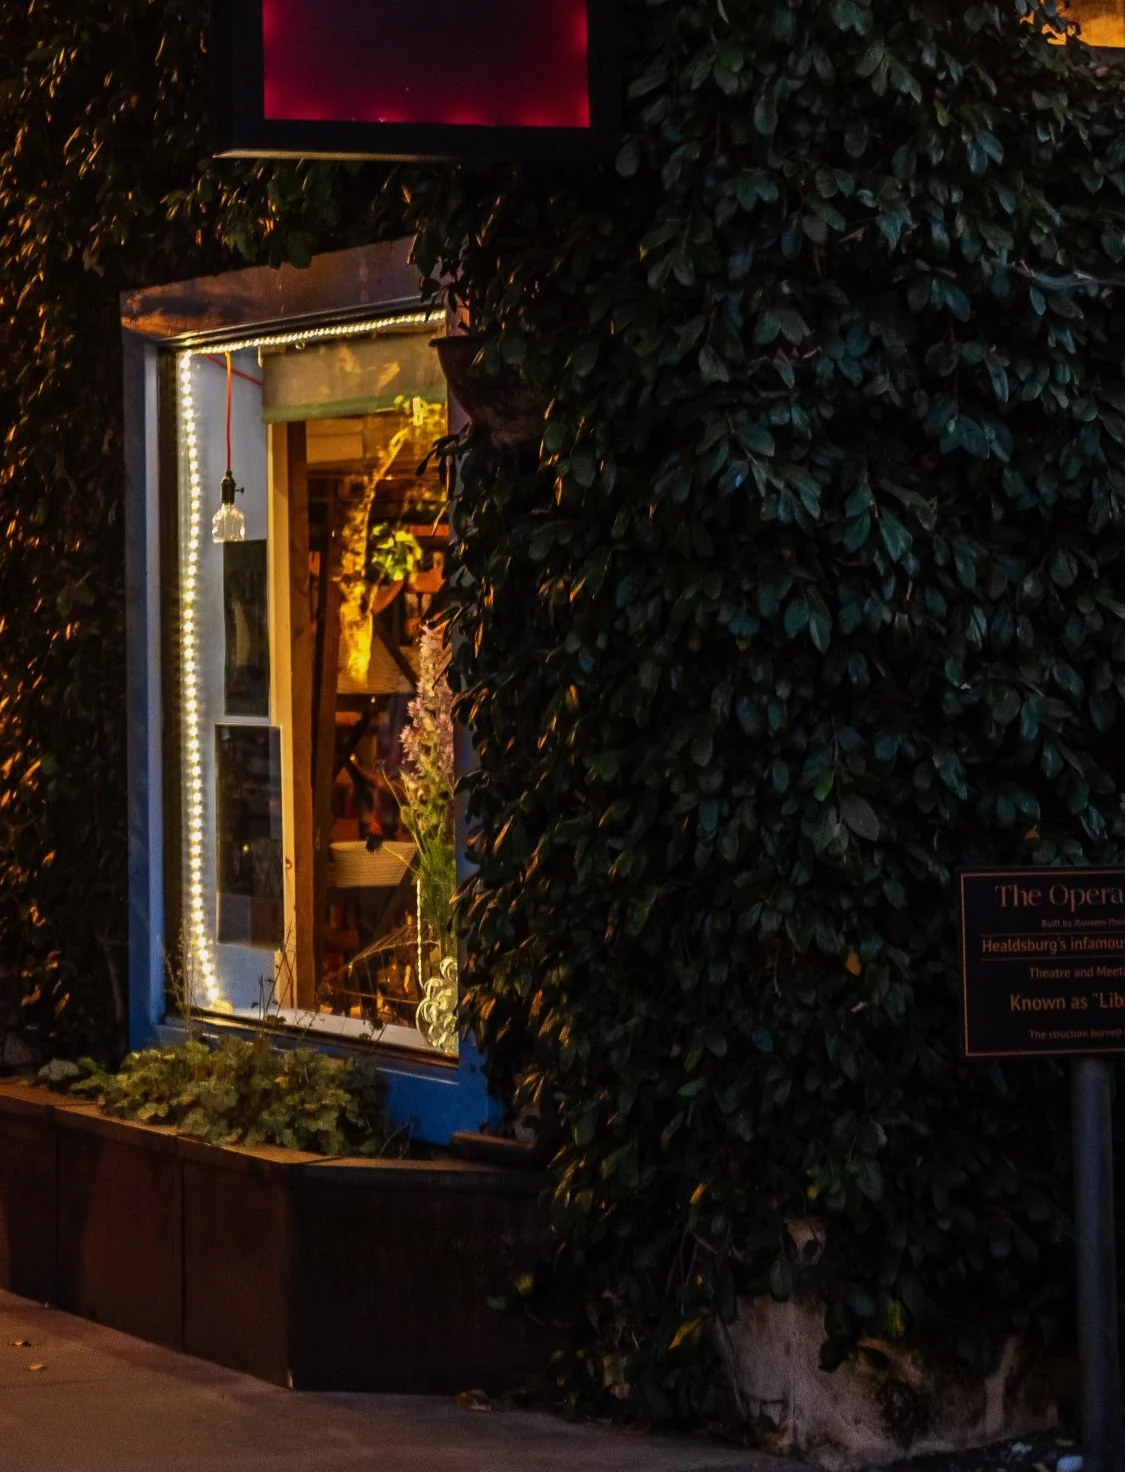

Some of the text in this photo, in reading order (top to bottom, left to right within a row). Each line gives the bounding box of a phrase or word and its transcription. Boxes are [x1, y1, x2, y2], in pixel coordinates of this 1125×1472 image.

[994, 883, 1125, 913] The Opera
[981, 936, 1125, 955] Healdsburg's infamou
[1029, 968, 1071, 980] Theatre
[1074, 966, 1094, 978] and
[1010, 991, 1125, 1012] Known as "Lib
[1029, 1030, 1047, 1040] The
